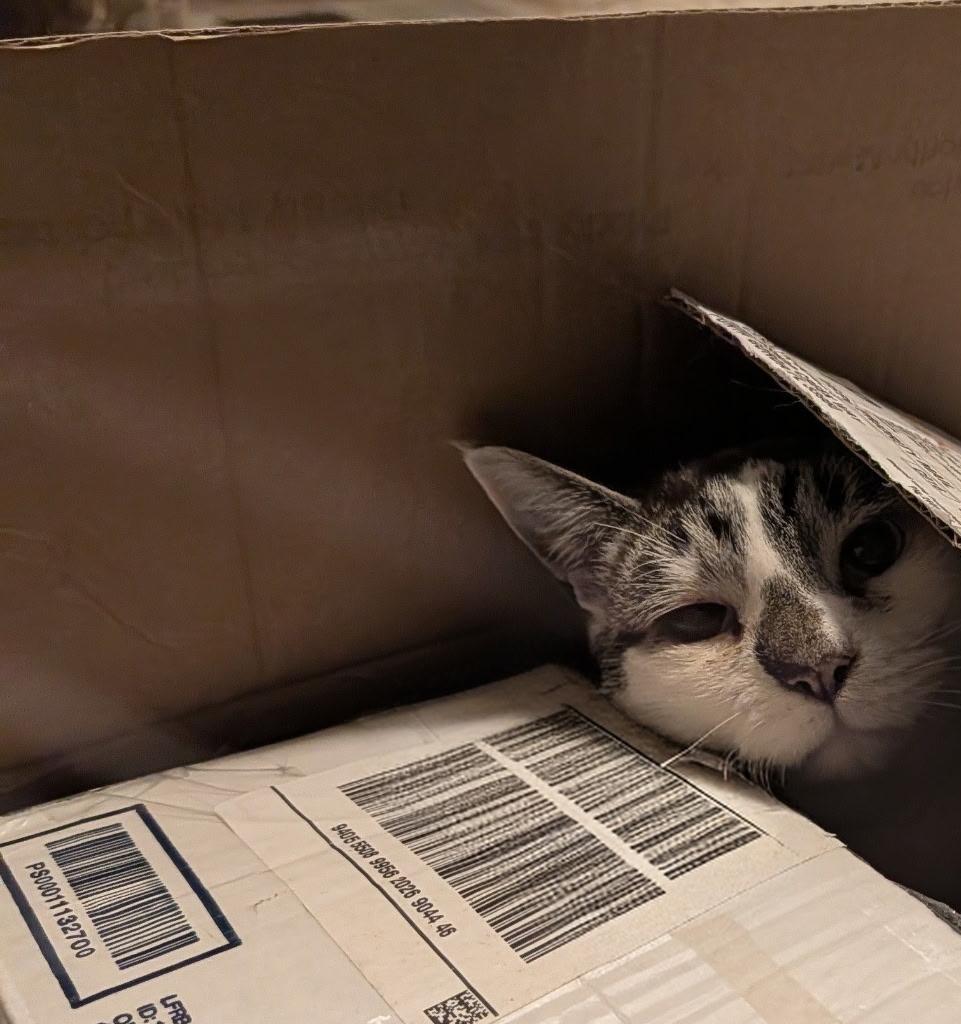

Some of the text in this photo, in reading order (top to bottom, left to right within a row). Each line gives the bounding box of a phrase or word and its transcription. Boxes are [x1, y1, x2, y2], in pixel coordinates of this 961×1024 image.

[25, 861, 96, 959] PS00011132700
[330, 823, 360, 844] 9405
[369, 857, 400, 879] 9956
[390, 876, 421, 899] 2026
[411, 897, 444, 925] 9044
[436, 923, 457, 938] 46
[137, 1003, 157, 1024] ID:
